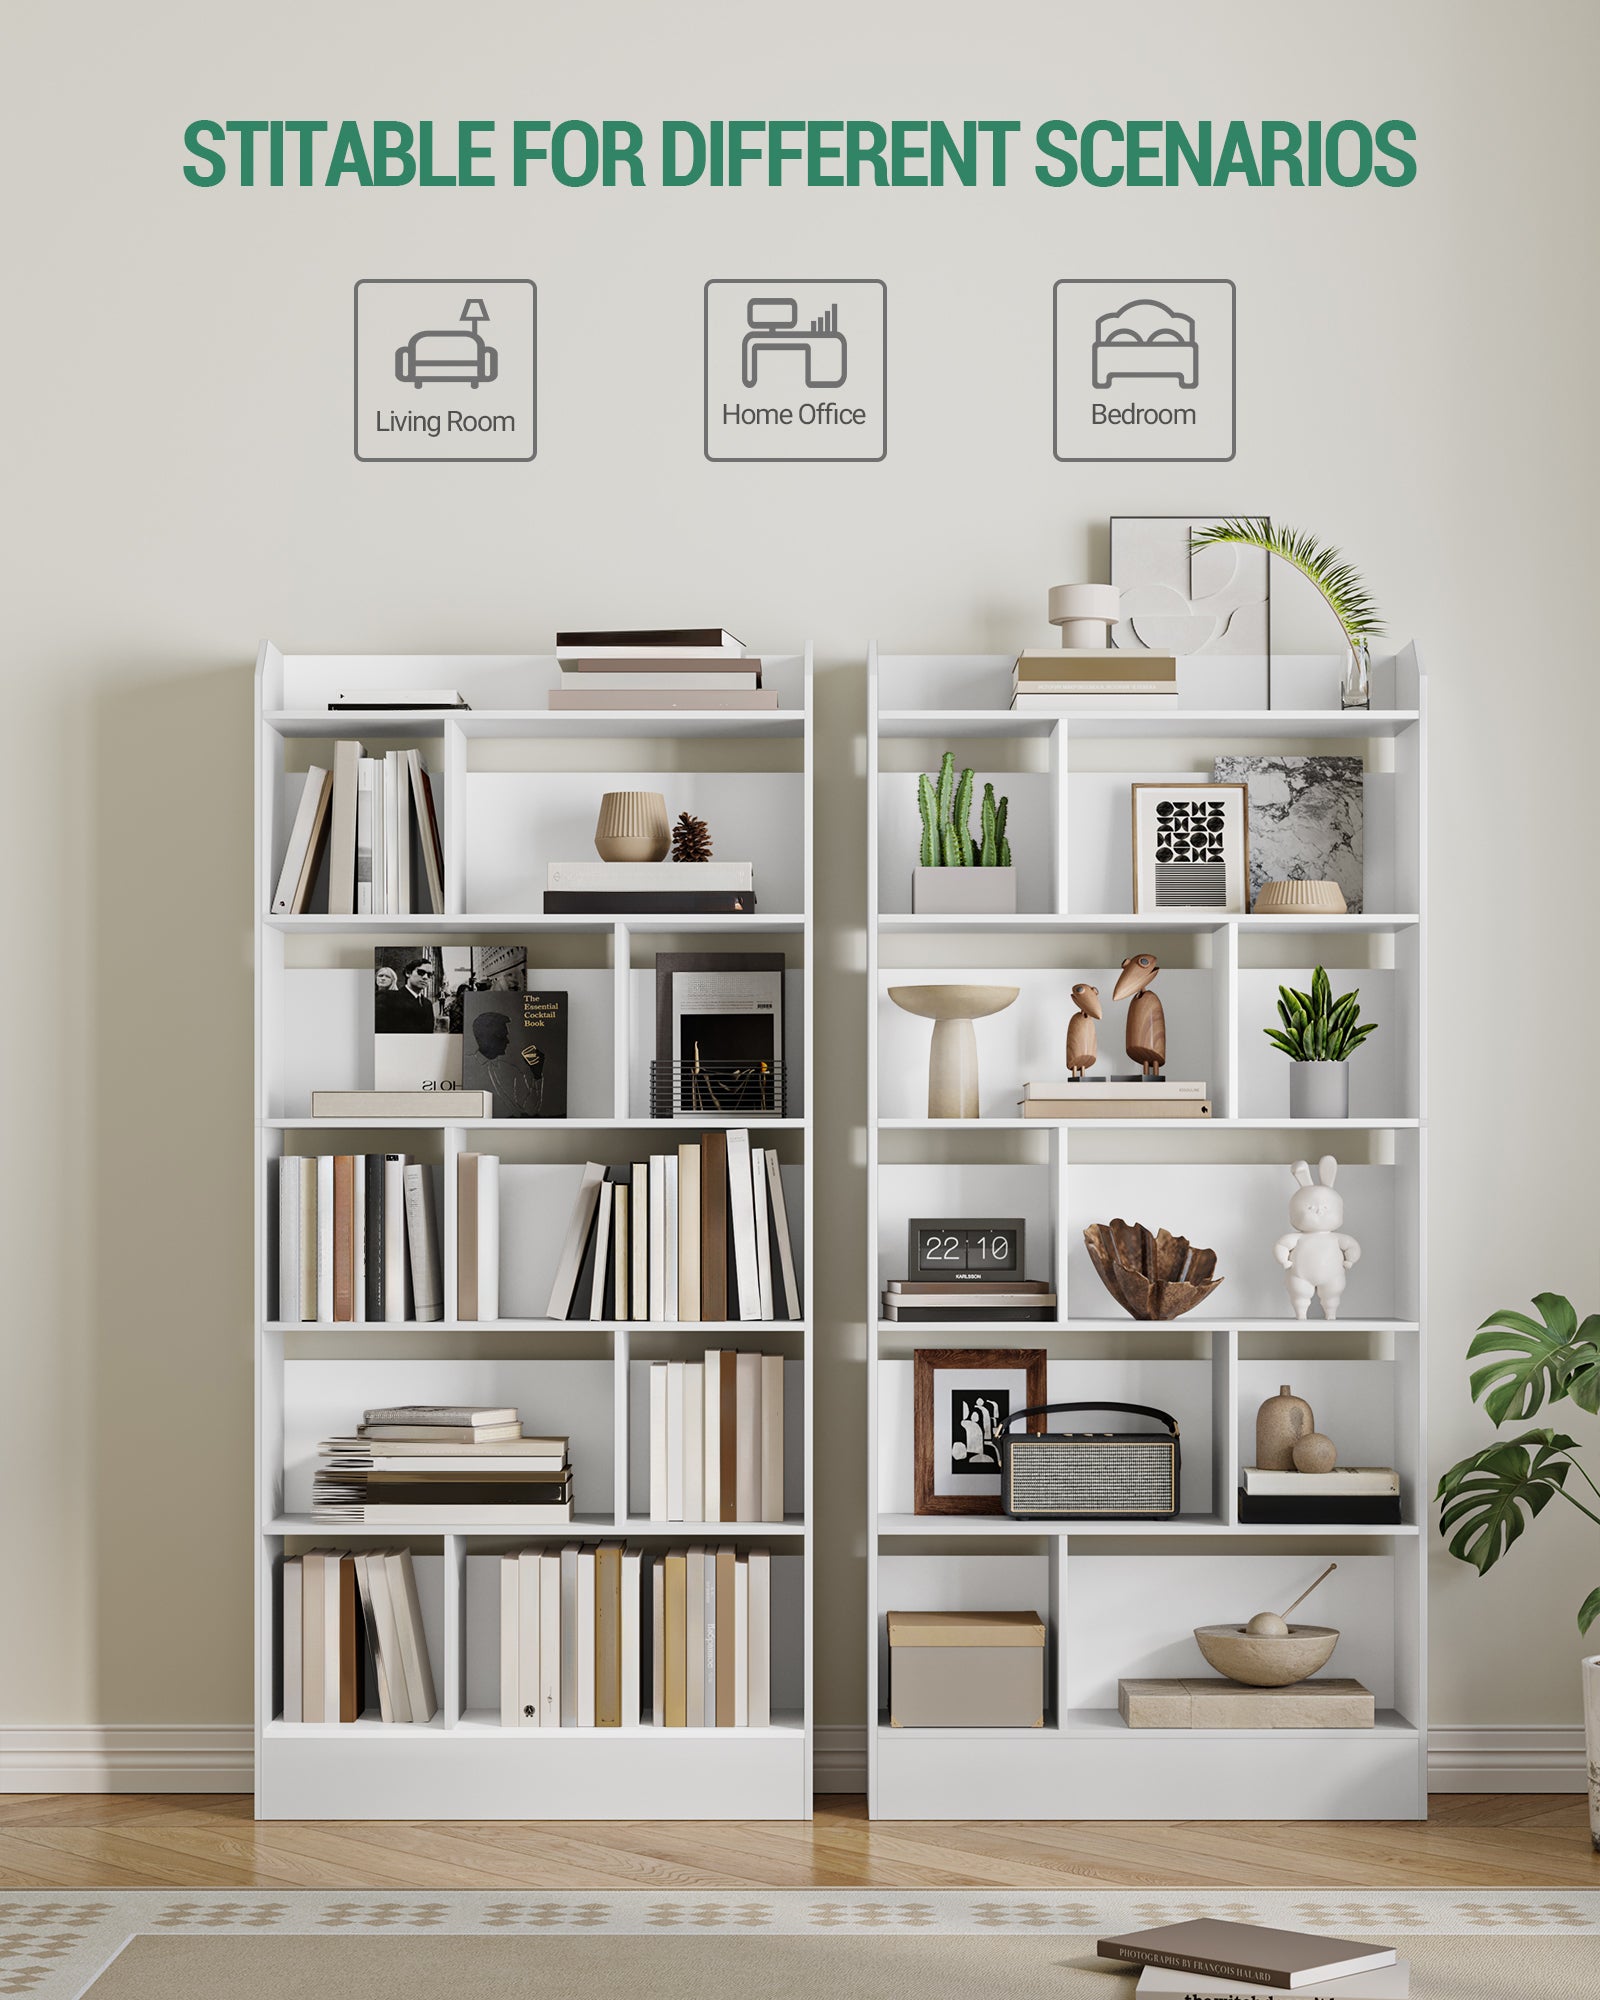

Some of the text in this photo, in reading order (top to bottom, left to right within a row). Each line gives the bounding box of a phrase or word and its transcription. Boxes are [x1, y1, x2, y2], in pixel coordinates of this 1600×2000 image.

[926, 1236, 1008, 1260] 22 10
[1119, 1948, 1272, 1982] PHOTOGRAPHS BY FRANÇOIS HALARD
